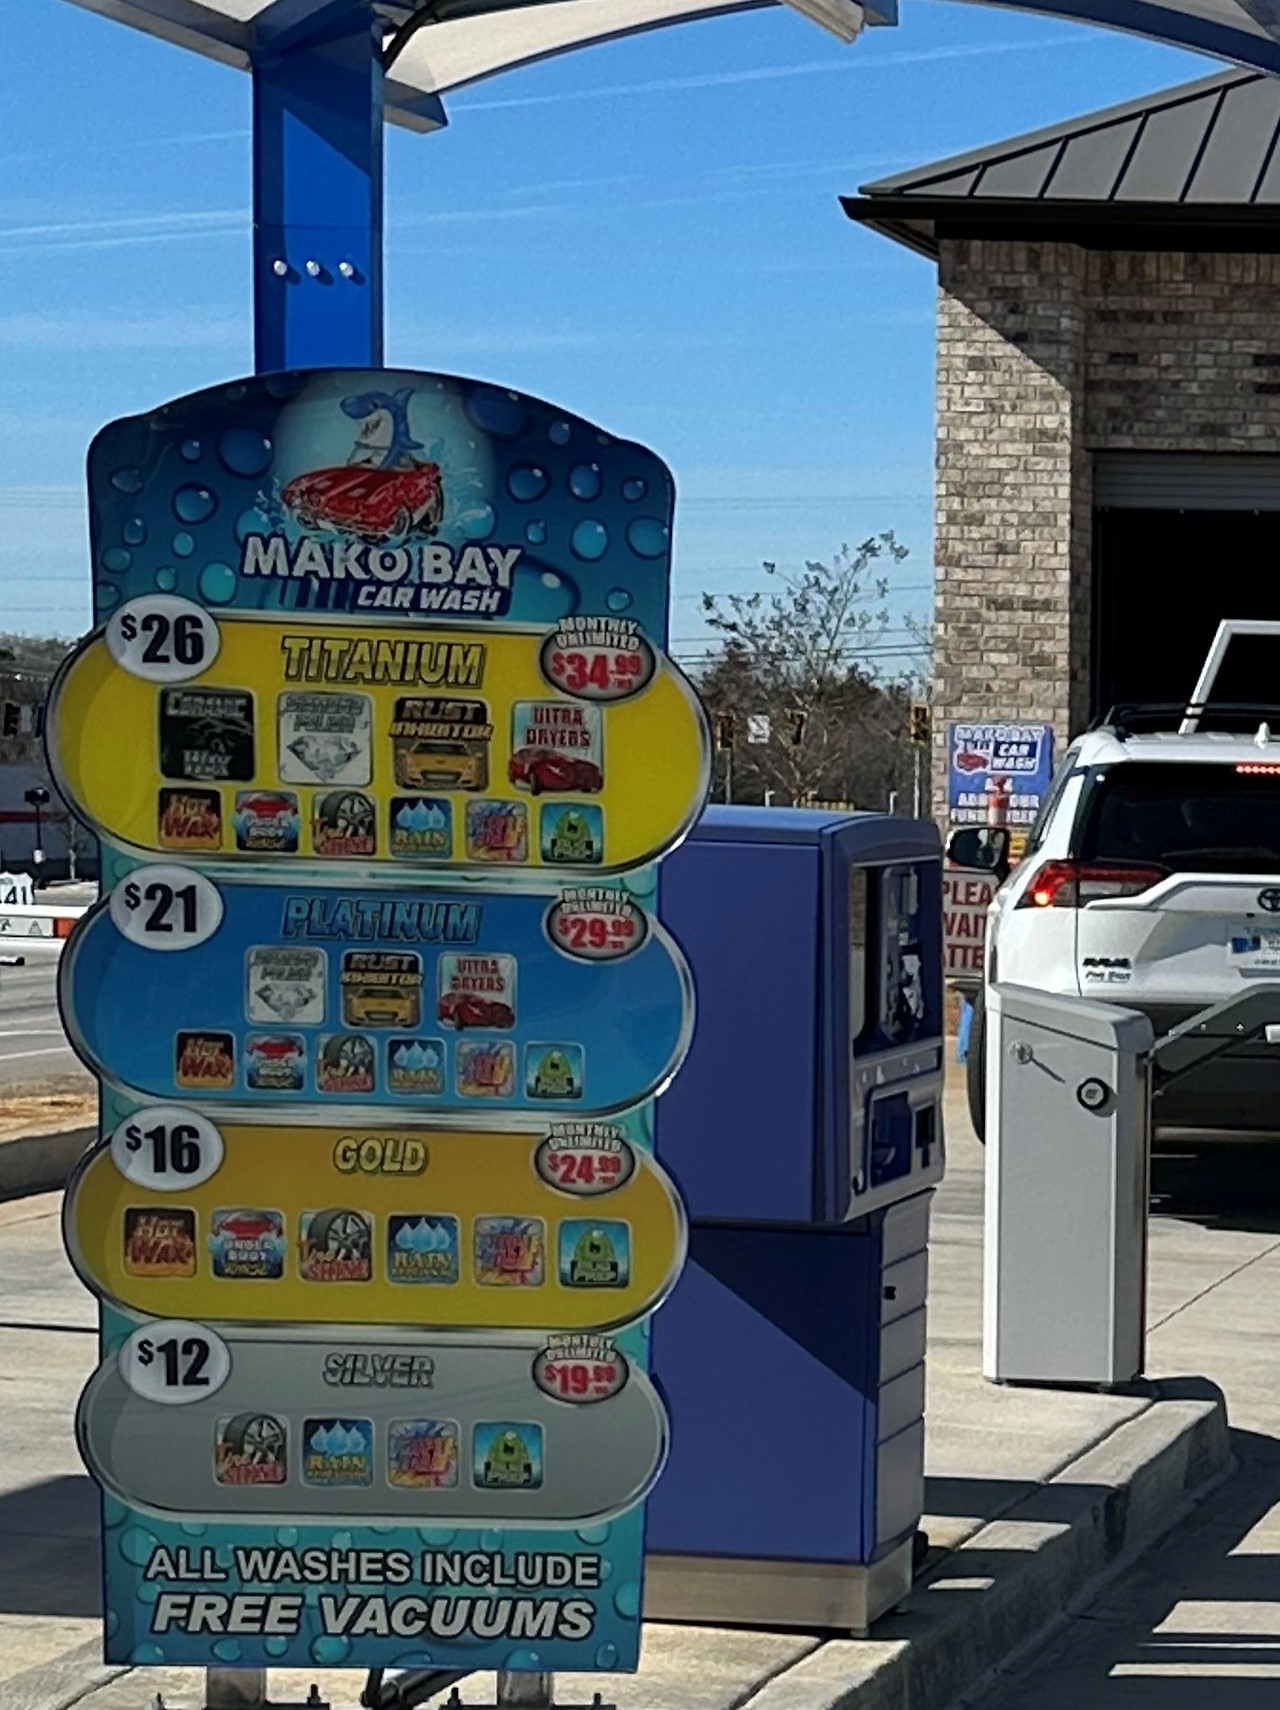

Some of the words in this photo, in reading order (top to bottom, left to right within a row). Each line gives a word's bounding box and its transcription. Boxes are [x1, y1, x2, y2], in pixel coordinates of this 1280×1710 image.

[243, 537, 408, 582] MAKO
[422, 545, 521, 588] BAY
[357, 585, 414, 608] CAR
[420, 588, 500, 612] WASH
[559, 616, 637, 635] MONTHLY
[121, 613, 204, 665] $26
[556, 632, 640, 651] UNLIMITED
[281, 636, 487, 688] TITANIUM
[403, 701, 481, 722] RUST
[534, 708, 583, 726] ULTRA
[527, 729, 592, 748] DRYERS
[956, 728, 1007, 741] MAKO
[1011, 728, 1043, 742] BAY
[998, 744, 1030, 756] CAR
[992, 757, 1036, 770] WASH
[1009, 794, 1039, 808] OUR
[125, 883, 197, 932] $21
[282, 898, 483, 943] PLATINUM
[350, 954, 416, 970] RUST
[457, 959, 499, 974] ULTRA
[126, 1125, 200, 1174] $16
[333, 1136, 429, 1176] GOLD
[135, 1215, 185, 1238] HOT
[127, 1236, 195, 1264] WAX
[393, 1252, 451, 1269] RAIN
[138, 1338, 209, 1386] $12
[323, 1352, 434, 1388] SILVER
[307, 1455, 366, 1471] RAIN
[145, 1547, 226, 1581] ALL
[237, 1549, 412, 1584] WASHES
[423, 1553, 599, 1587] INCLUDE
[152, 1594, 302, 1634] FREE
[320, 1598, 595, 1639] VACUUMS
